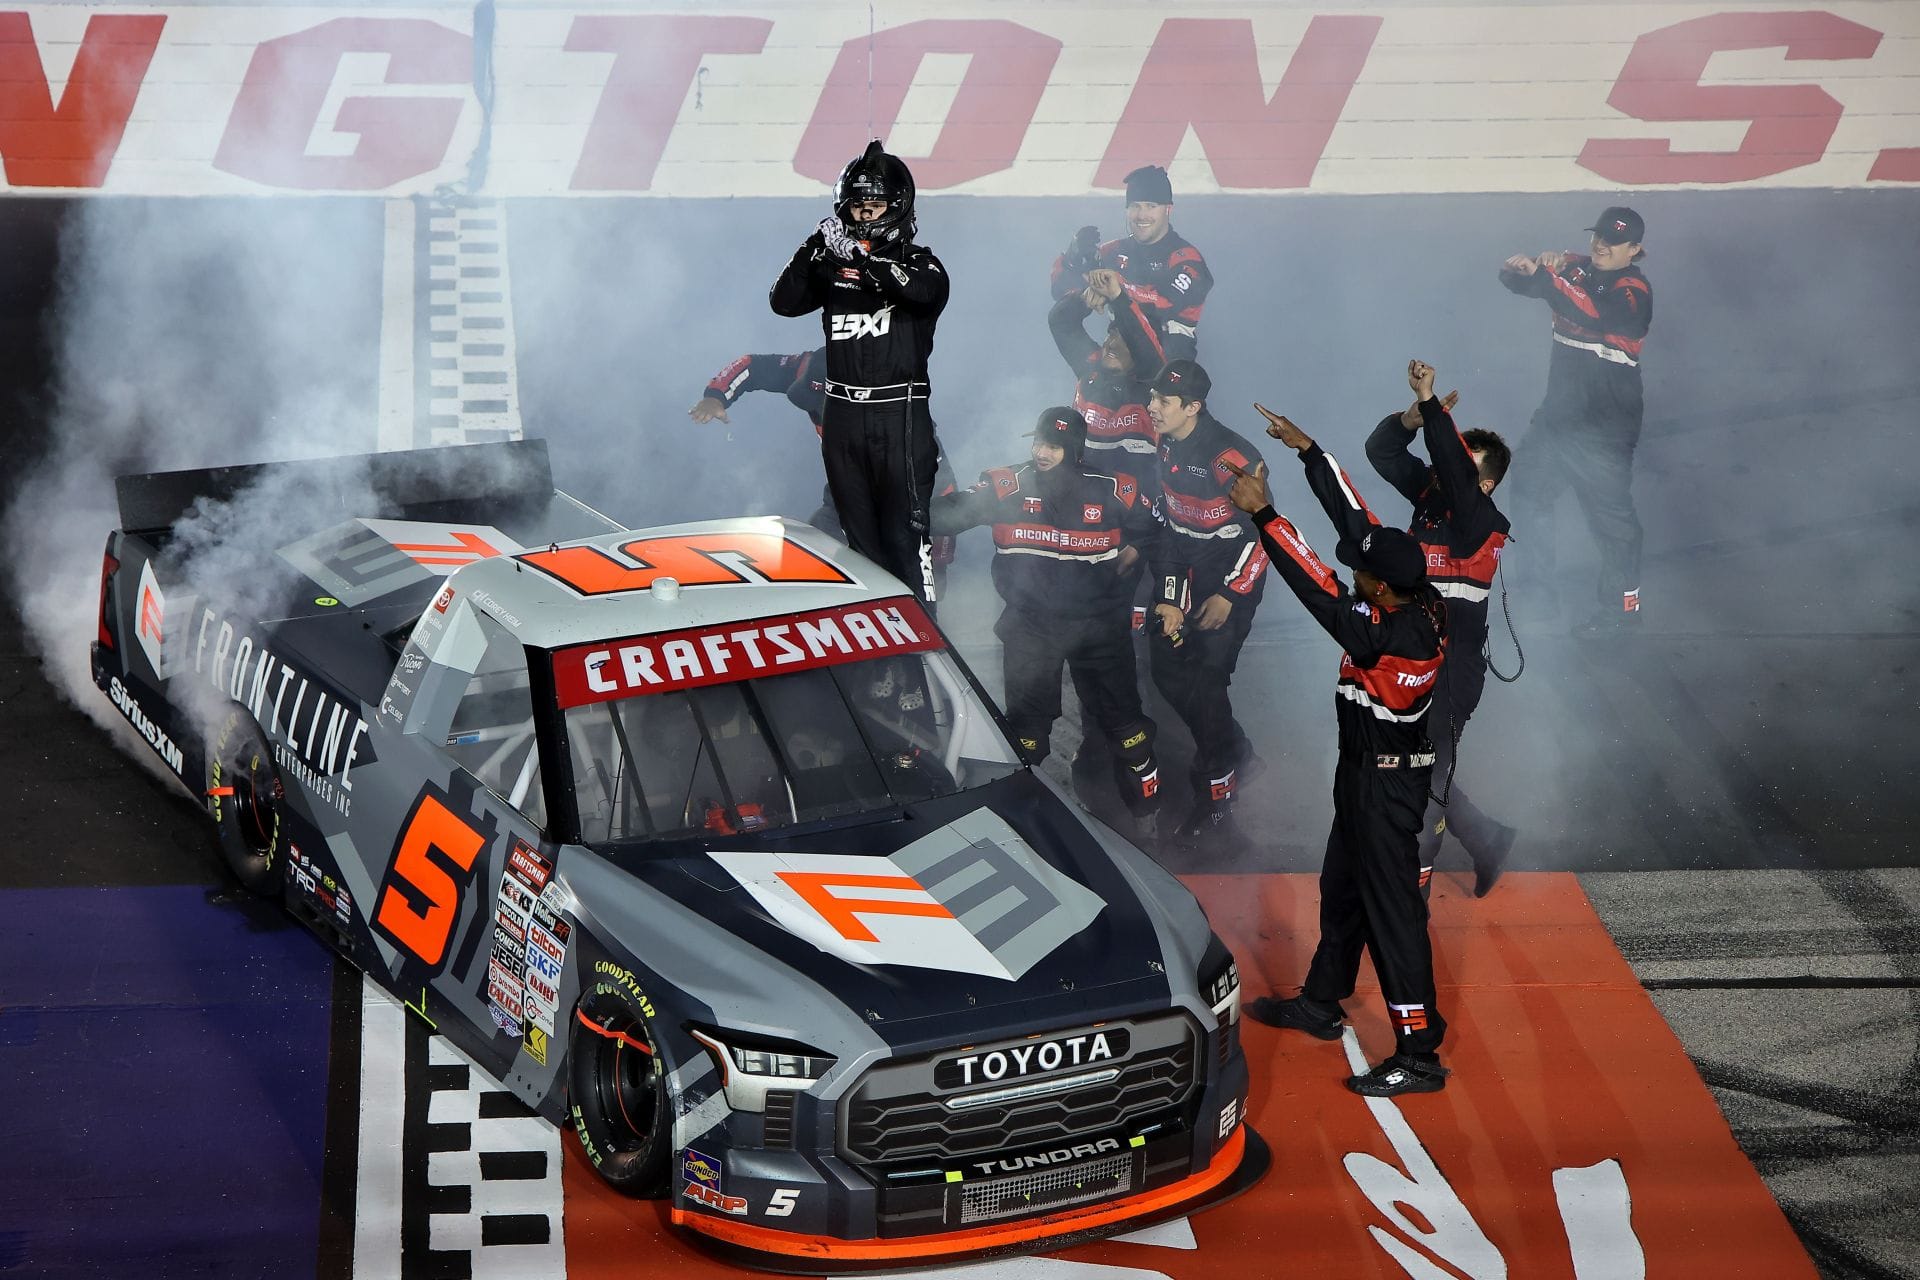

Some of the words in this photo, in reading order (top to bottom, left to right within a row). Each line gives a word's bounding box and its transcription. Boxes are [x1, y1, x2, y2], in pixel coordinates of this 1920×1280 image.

[1070, 536, 1110, 548] GARAGE
[1278, 524, 1300, 549] TRICON
[1304, 554, 1327, 579] GARAGE
[519, 532, 858, 596] 5
[484, 596, 505, 616] COREY
[502, 611, 523, 628] HEIM
[584, 606, 921, 694] CRAFTSMAN
[195, 607, 369, 792] FRONTLINE
[110, 675, 184, 776] SiriusXM
[273, 742, 333, 804] ENTERPRISES
[334, 787, 352, 818] INC
[288, 859, 316, 894] TRD
[377, 793, 486, 967] 5
[511, 851, 546, 883] CRAFTSMAN
[497, 900, 524, 928] LINCOLN
[534, 901, 556, 931] Holley
[494, 927, 525, 958] COMETIC
[530, 925, 563, 964] tilton
[491, 944, 526, 982] JESEL
[527, 946, 560, 980] SKF
[488, 981, 523, 1018] CALICO
[498, 973, 520, 999] brembo
[594, 960, 656, 1019] GOODYEAR
[957, 1032, 1113, 1085] TOYOTA
[685, 1161, 719, 1180] SUNOCO
[972, 1138, 1120, 1175] TUNDRA
[685, 1183, 748, 1211] ARP
[764, 1188, 801, 1217] 5
